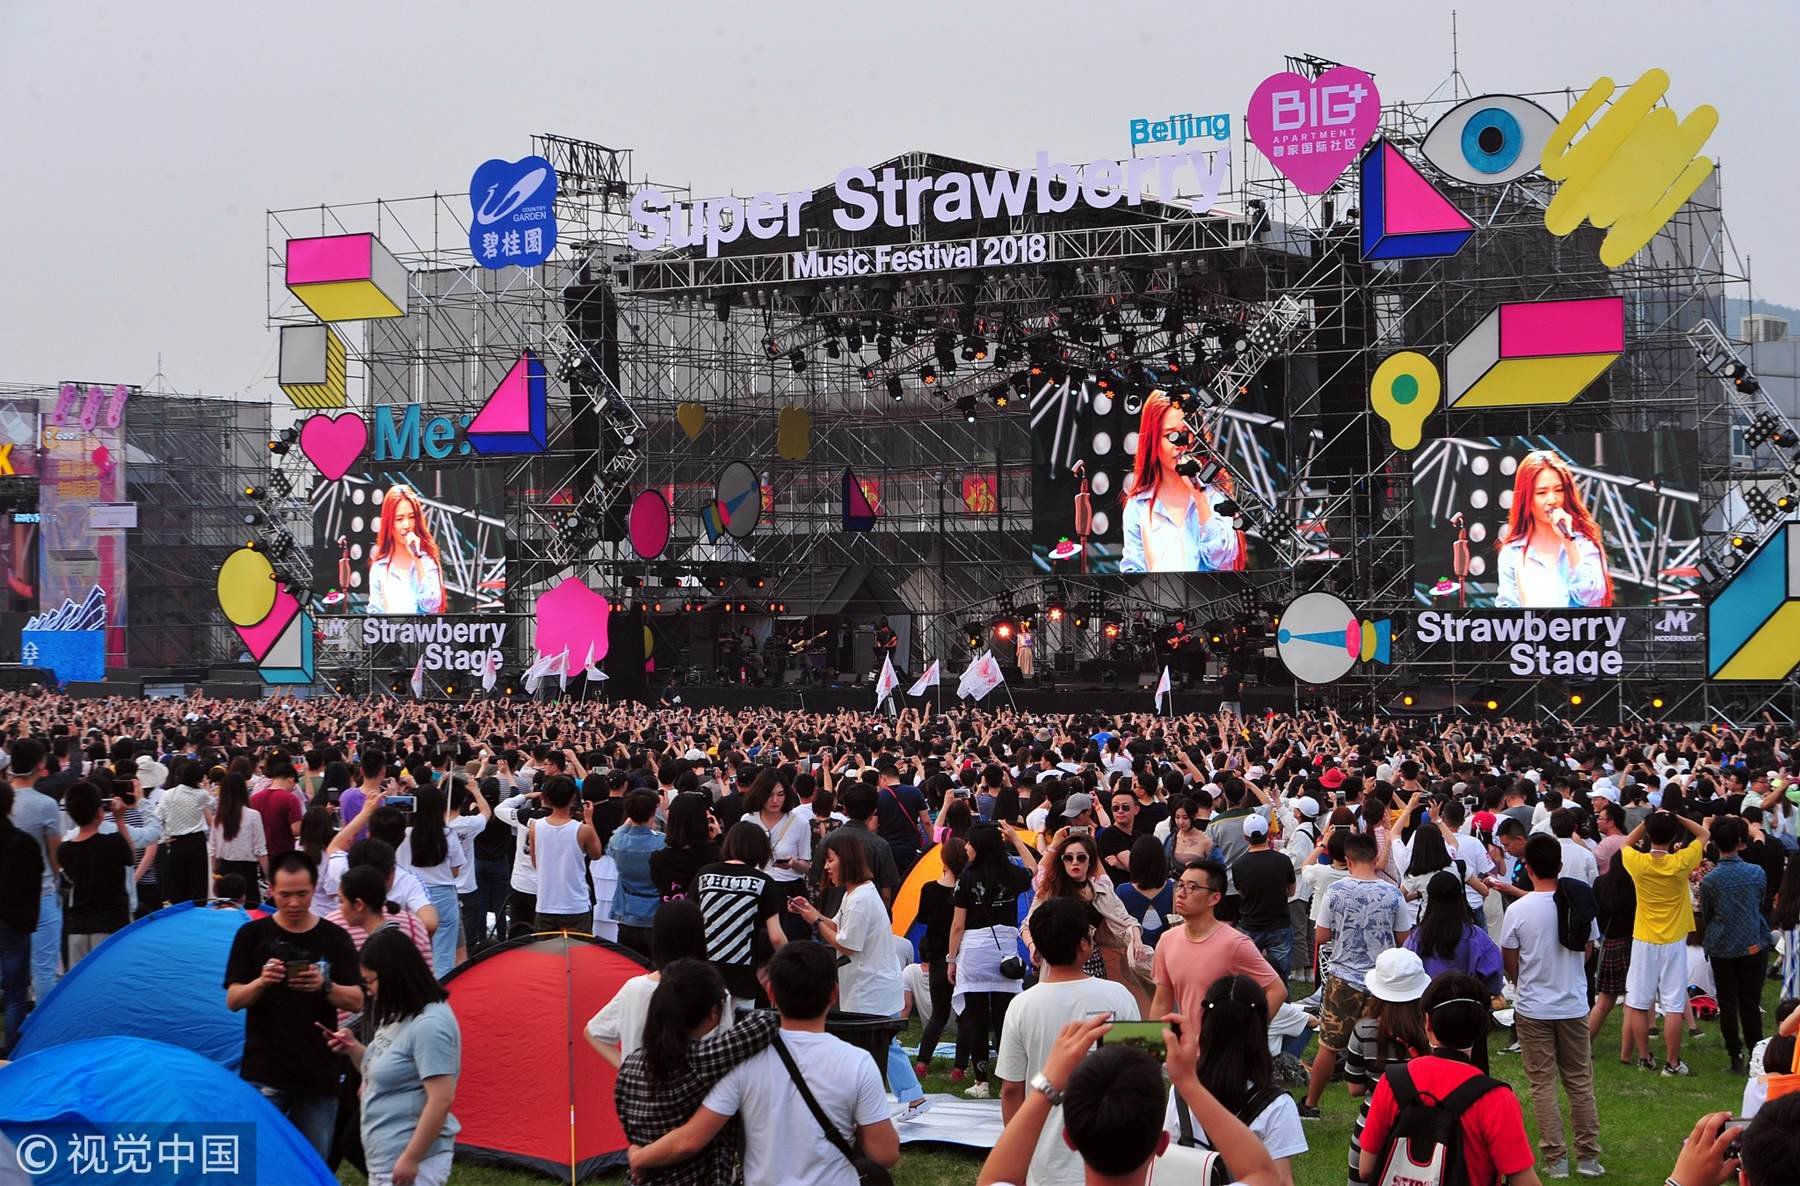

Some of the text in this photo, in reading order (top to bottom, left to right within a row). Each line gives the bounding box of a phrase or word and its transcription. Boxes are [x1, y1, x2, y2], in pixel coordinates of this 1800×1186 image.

[1130, 113, 1230, 145] Beijing
[1273, 128, 1356, 144] APARTMENT
[513, 211, 547, 222] GARDEN
[522, 205, 546, 213] COUNTRY
[628, 148, 1230, 257] Super Strawberry
[482, 227, 542, 259] 碧桂園
[793, 234, 1046, 279] Music Festival 2018
[362, 617, 507, 648] Strawberry
[1416, 611, 1626, 647] Strawberry
[424, 643, 504, 677] Stage
[1510, 643, 1624, 680] Stage
